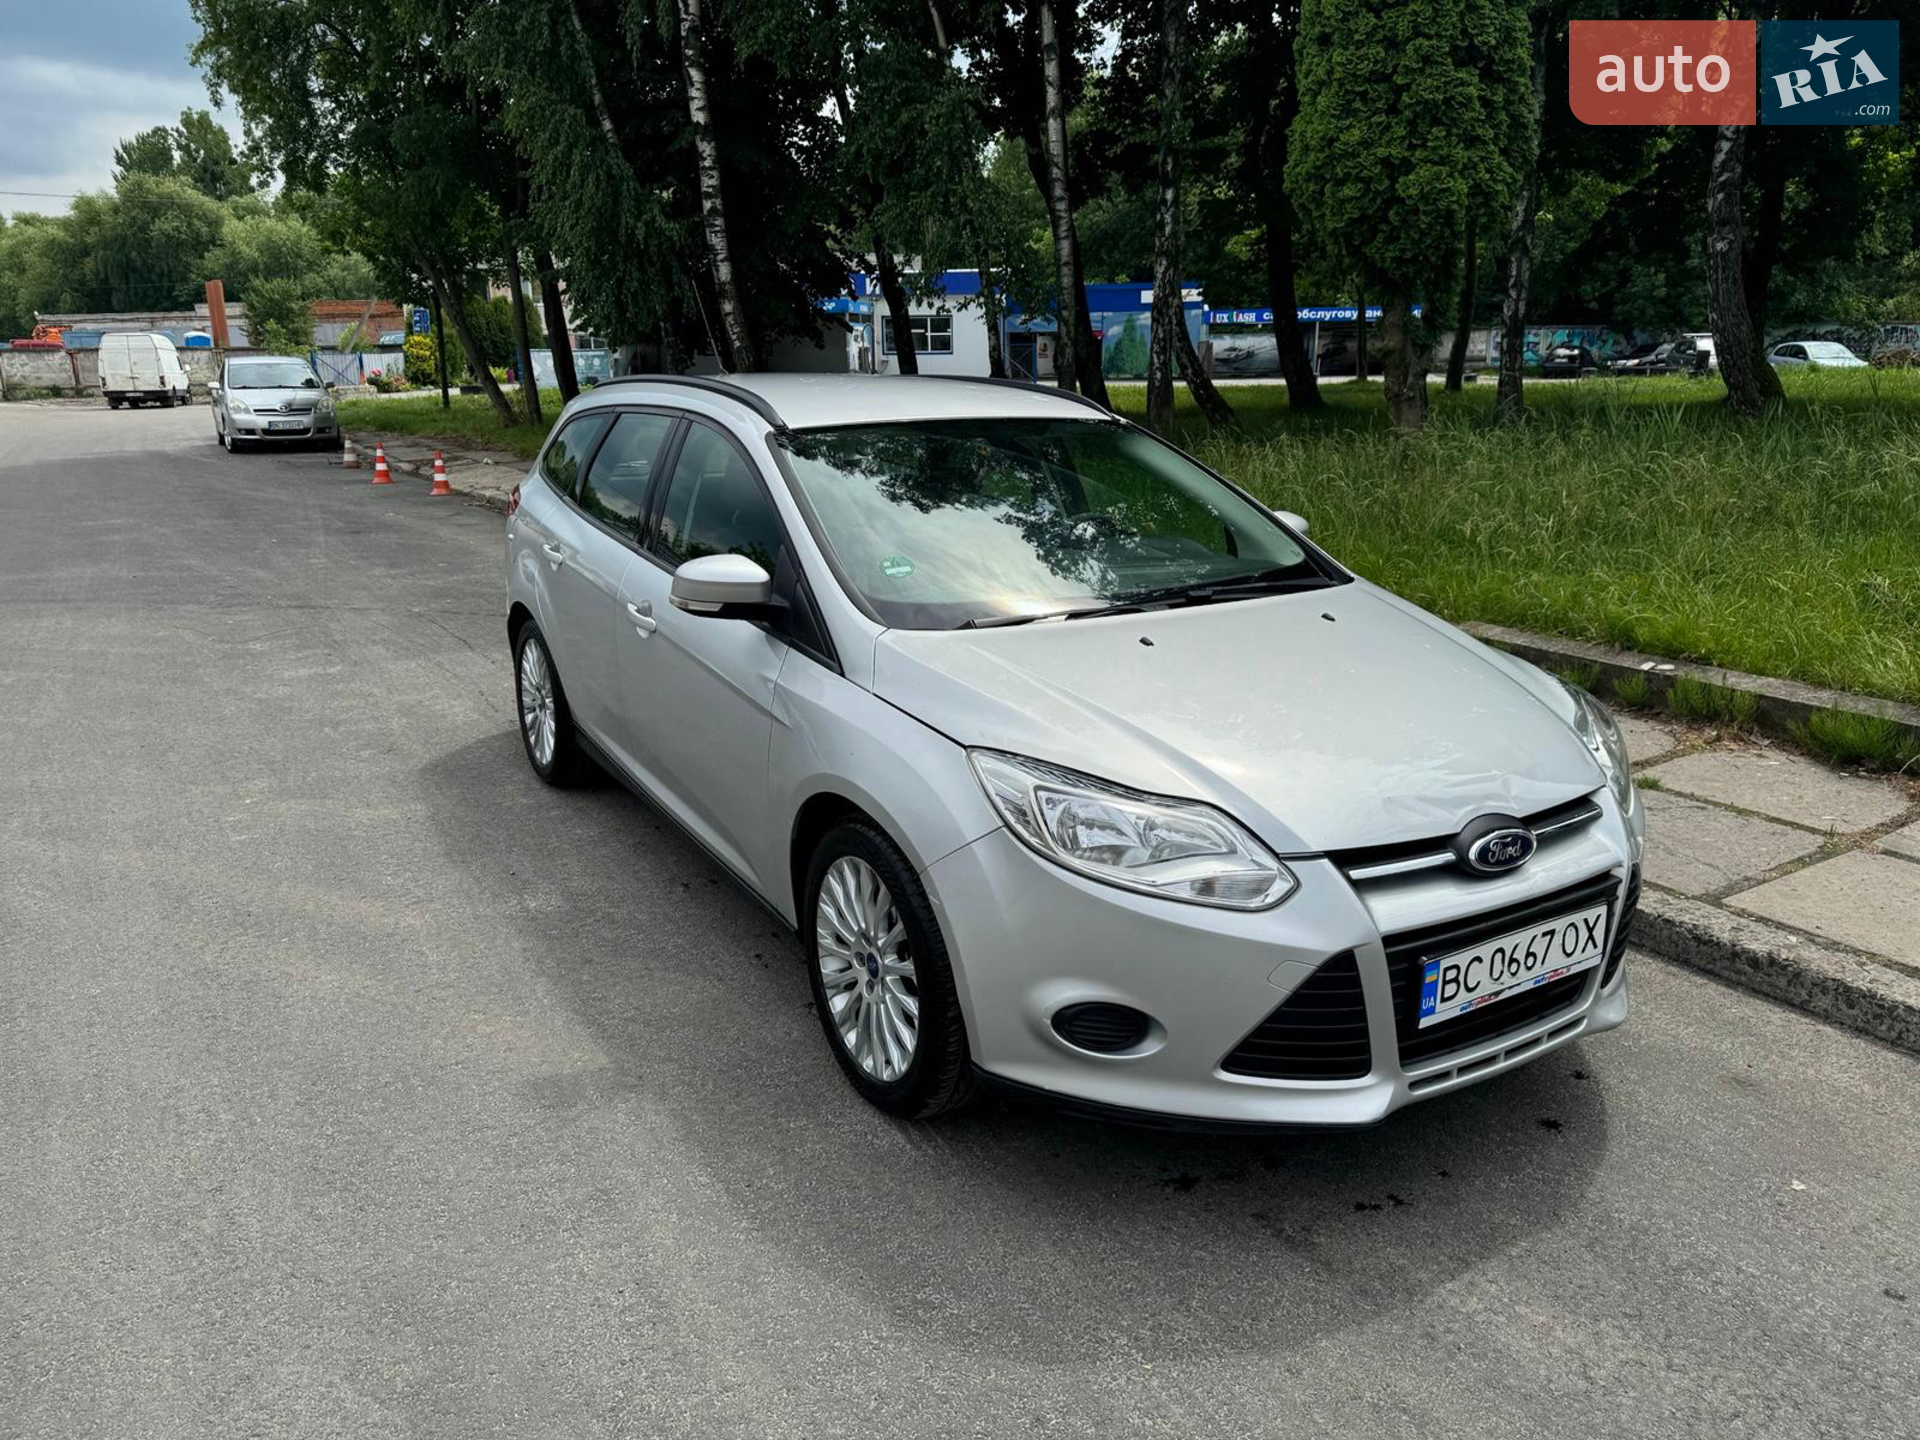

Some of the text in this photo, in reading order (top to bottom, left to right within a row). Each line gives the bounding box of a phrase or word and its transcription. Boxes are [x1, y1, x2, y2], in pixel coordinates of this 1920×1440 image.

[1488, 836, 1523, 863] Ford
[1439, 913, 1602, 1003] BC 0667 OX
[1422, 995, 1435, 1010] UA
